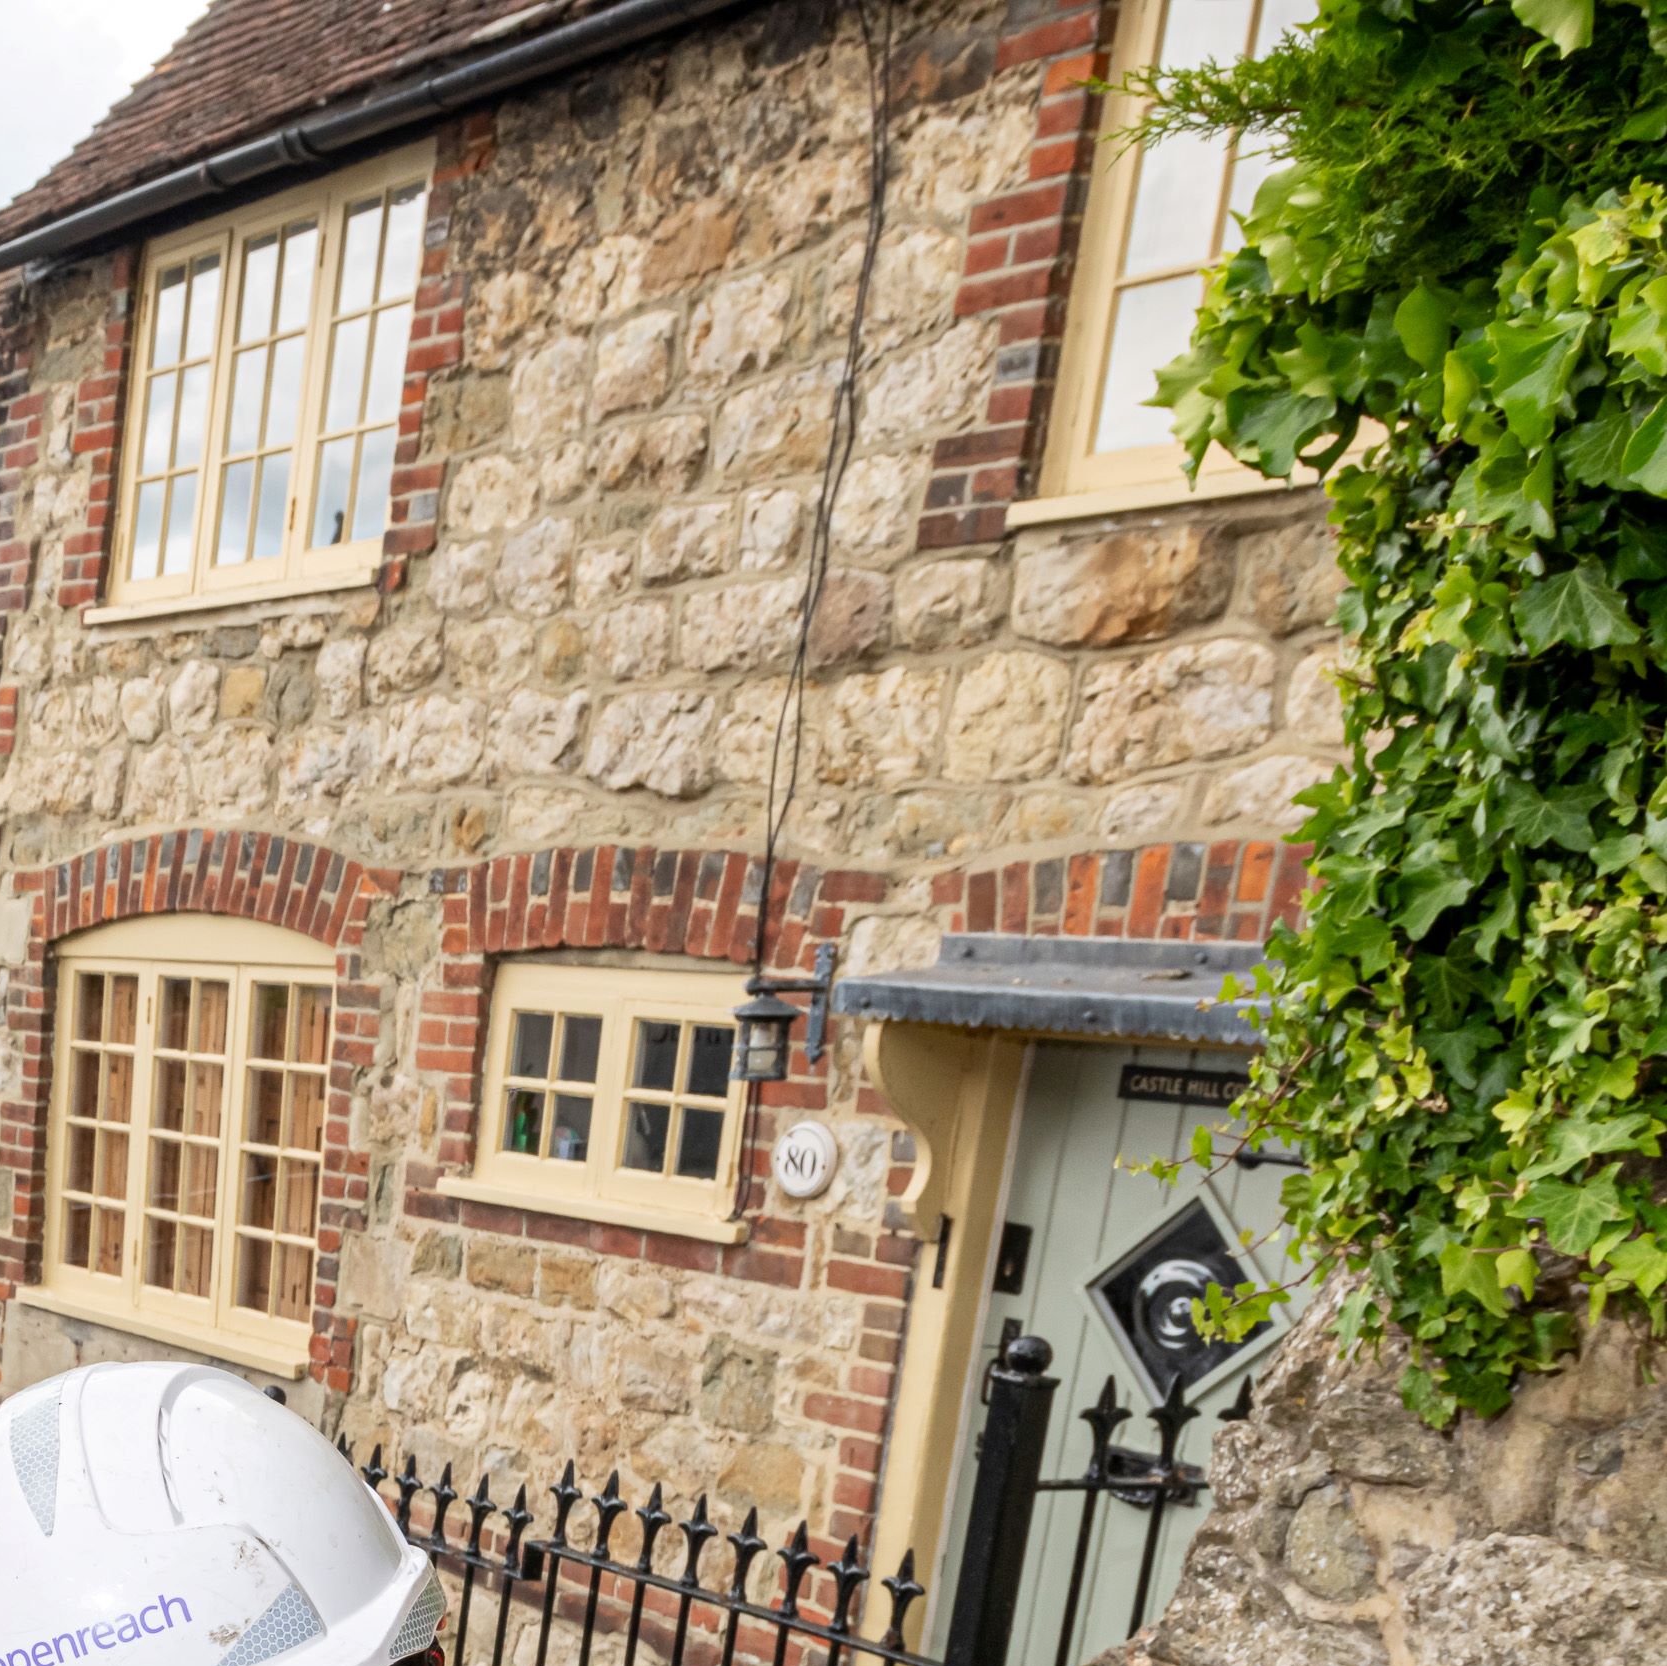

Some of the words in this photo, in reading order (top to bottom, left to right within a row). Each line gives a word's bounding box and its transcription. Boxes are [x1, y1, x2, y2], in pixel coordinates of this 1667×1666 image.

[1130, 1074, 1183, 1096] CASTLE
[1186, 1079, 1220, 1099] HILL
[784, 1145, 817, 1180] 80
